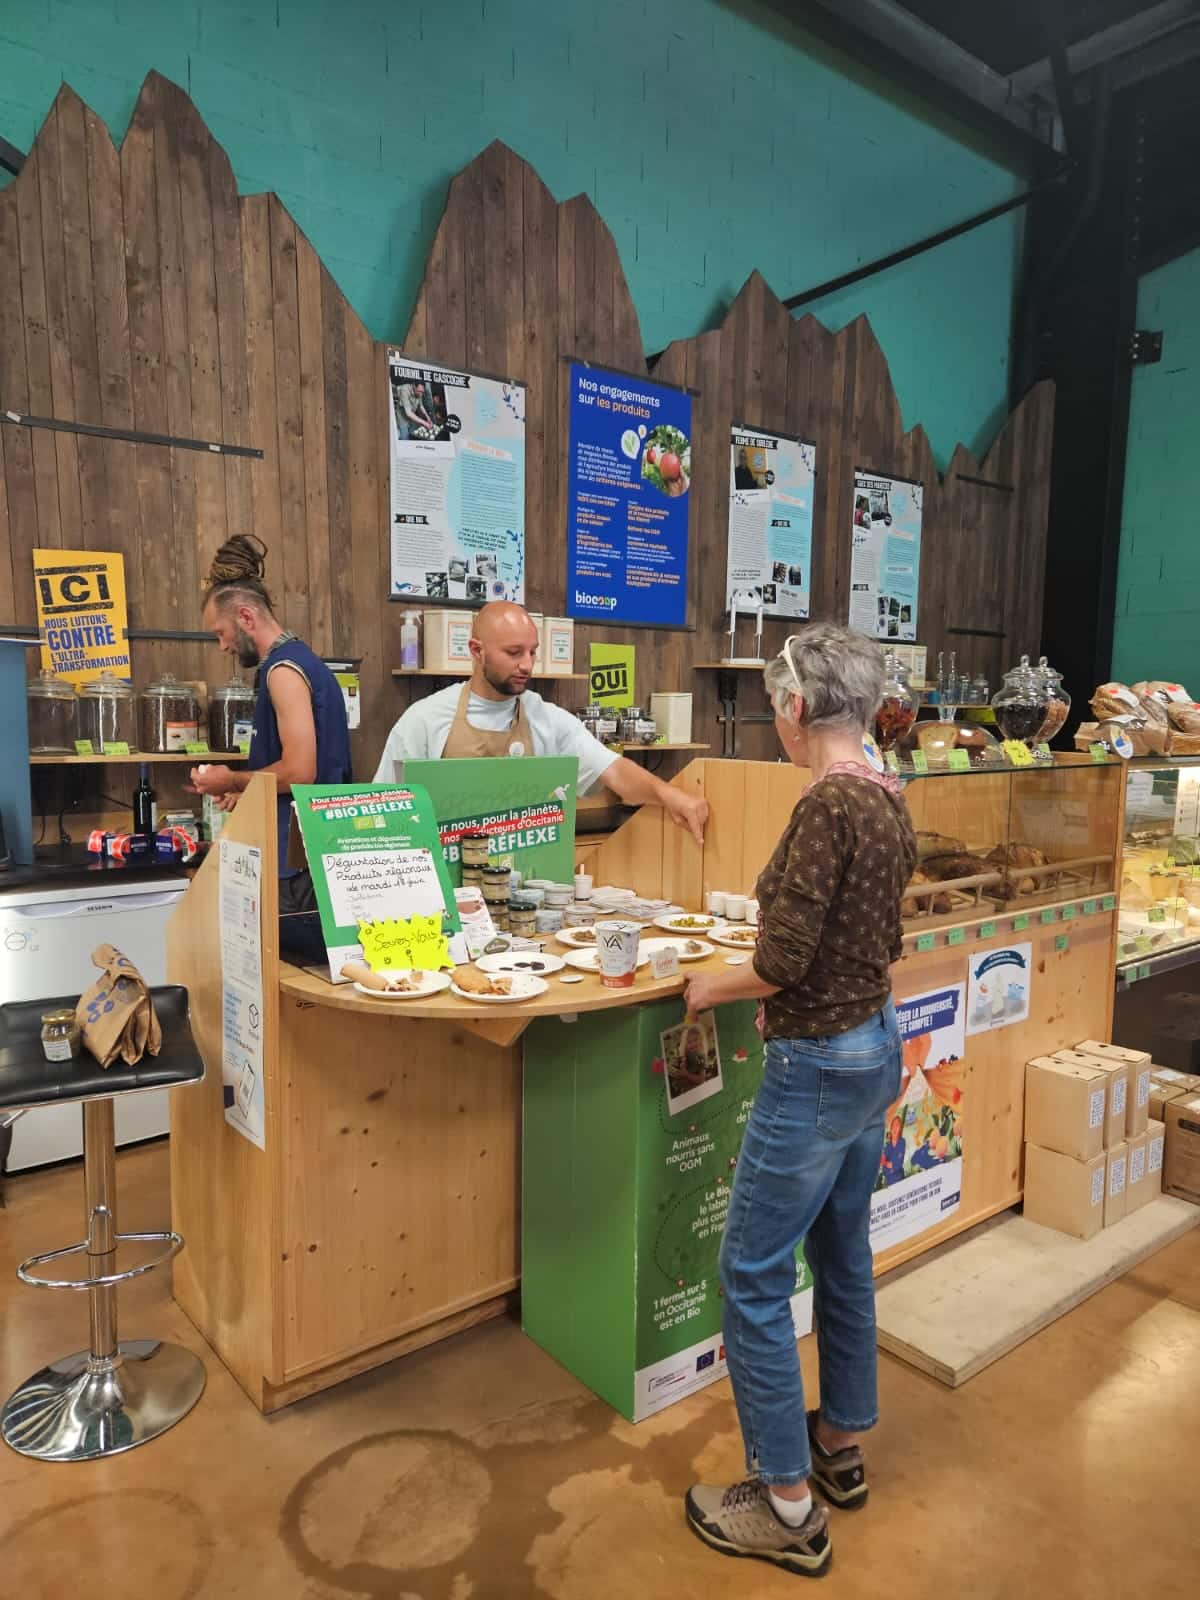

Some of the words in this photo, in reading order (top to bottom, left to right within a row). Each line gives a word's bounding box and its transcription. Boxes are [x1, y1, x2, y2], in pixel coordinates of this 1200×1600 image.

[433, 373, 468, 387] GASCOGNE
[579, 378, 598, 392] Nos
[600, 384, 660, 407] engagements
[578, 394, 596, 405] sur
[597, 398, 610, 409] les
[612, 402, 651, 418] produits
[39, 574, 110, 605] ICI
[575, 590, 617, 611] biocoop
[44, 618, 68, 630] NOUS
[71, 614, 108, 627] LUTTONS
[48, 625, 116, 650] CONTRE
[51, 655, 130, 673] TRANSFORMATION
[591, 670, 628, 690] OUI
[311, 796, 330, 804] Pour
[353, 792, 371, 801] pour
[325, 805, 358, 820] #BIO
[362, 800, 413, 816] RÉFLEXE
[437, 822, 448, 834] ur
[450, 818, 481, 833] nous,
[482, 812, 509, 830] pour
[510, 810, 520, 820] la
[521, 804, 562, 818] planète,
[444, 834, 461, 844] nos
[517, 813, 563, 830] d'Occitanie
[488, 826, 557, 854] RÉFLEXE
[327, 855, 394, 872] Dégustation
[396, 855, 410, 864] de
[336, 869, 382, 881] Produits
[361, 879, 392, 891] mardi
[912, 1007, 920, 1019] LA
[673, 1133, 709, 1152] Animaux
[666, 1149, 696, 1167] nourris
[697, 1142, 715, 1156] sans
[679, 1157, 703, 1172] OGM
[699, 1204, 708, 1216] le
[708, 1195, 728, 1212] label
[705, 1191, 716, 1202] Le
[692, 1216, 710, 1233] plus
[698, 1229, 710, 1240] en
[660, 1290, 686, 1308] ferme
[687, 1284, 700, 1297] sur
[654, 1311, 666, 1322] en
[666, 1293, 706, 1316] Occitanie
[659, 1318, 673, 1331] est
[674, 1313, 686, 1325] en
[687, 1306, 701, 1319] Bio
